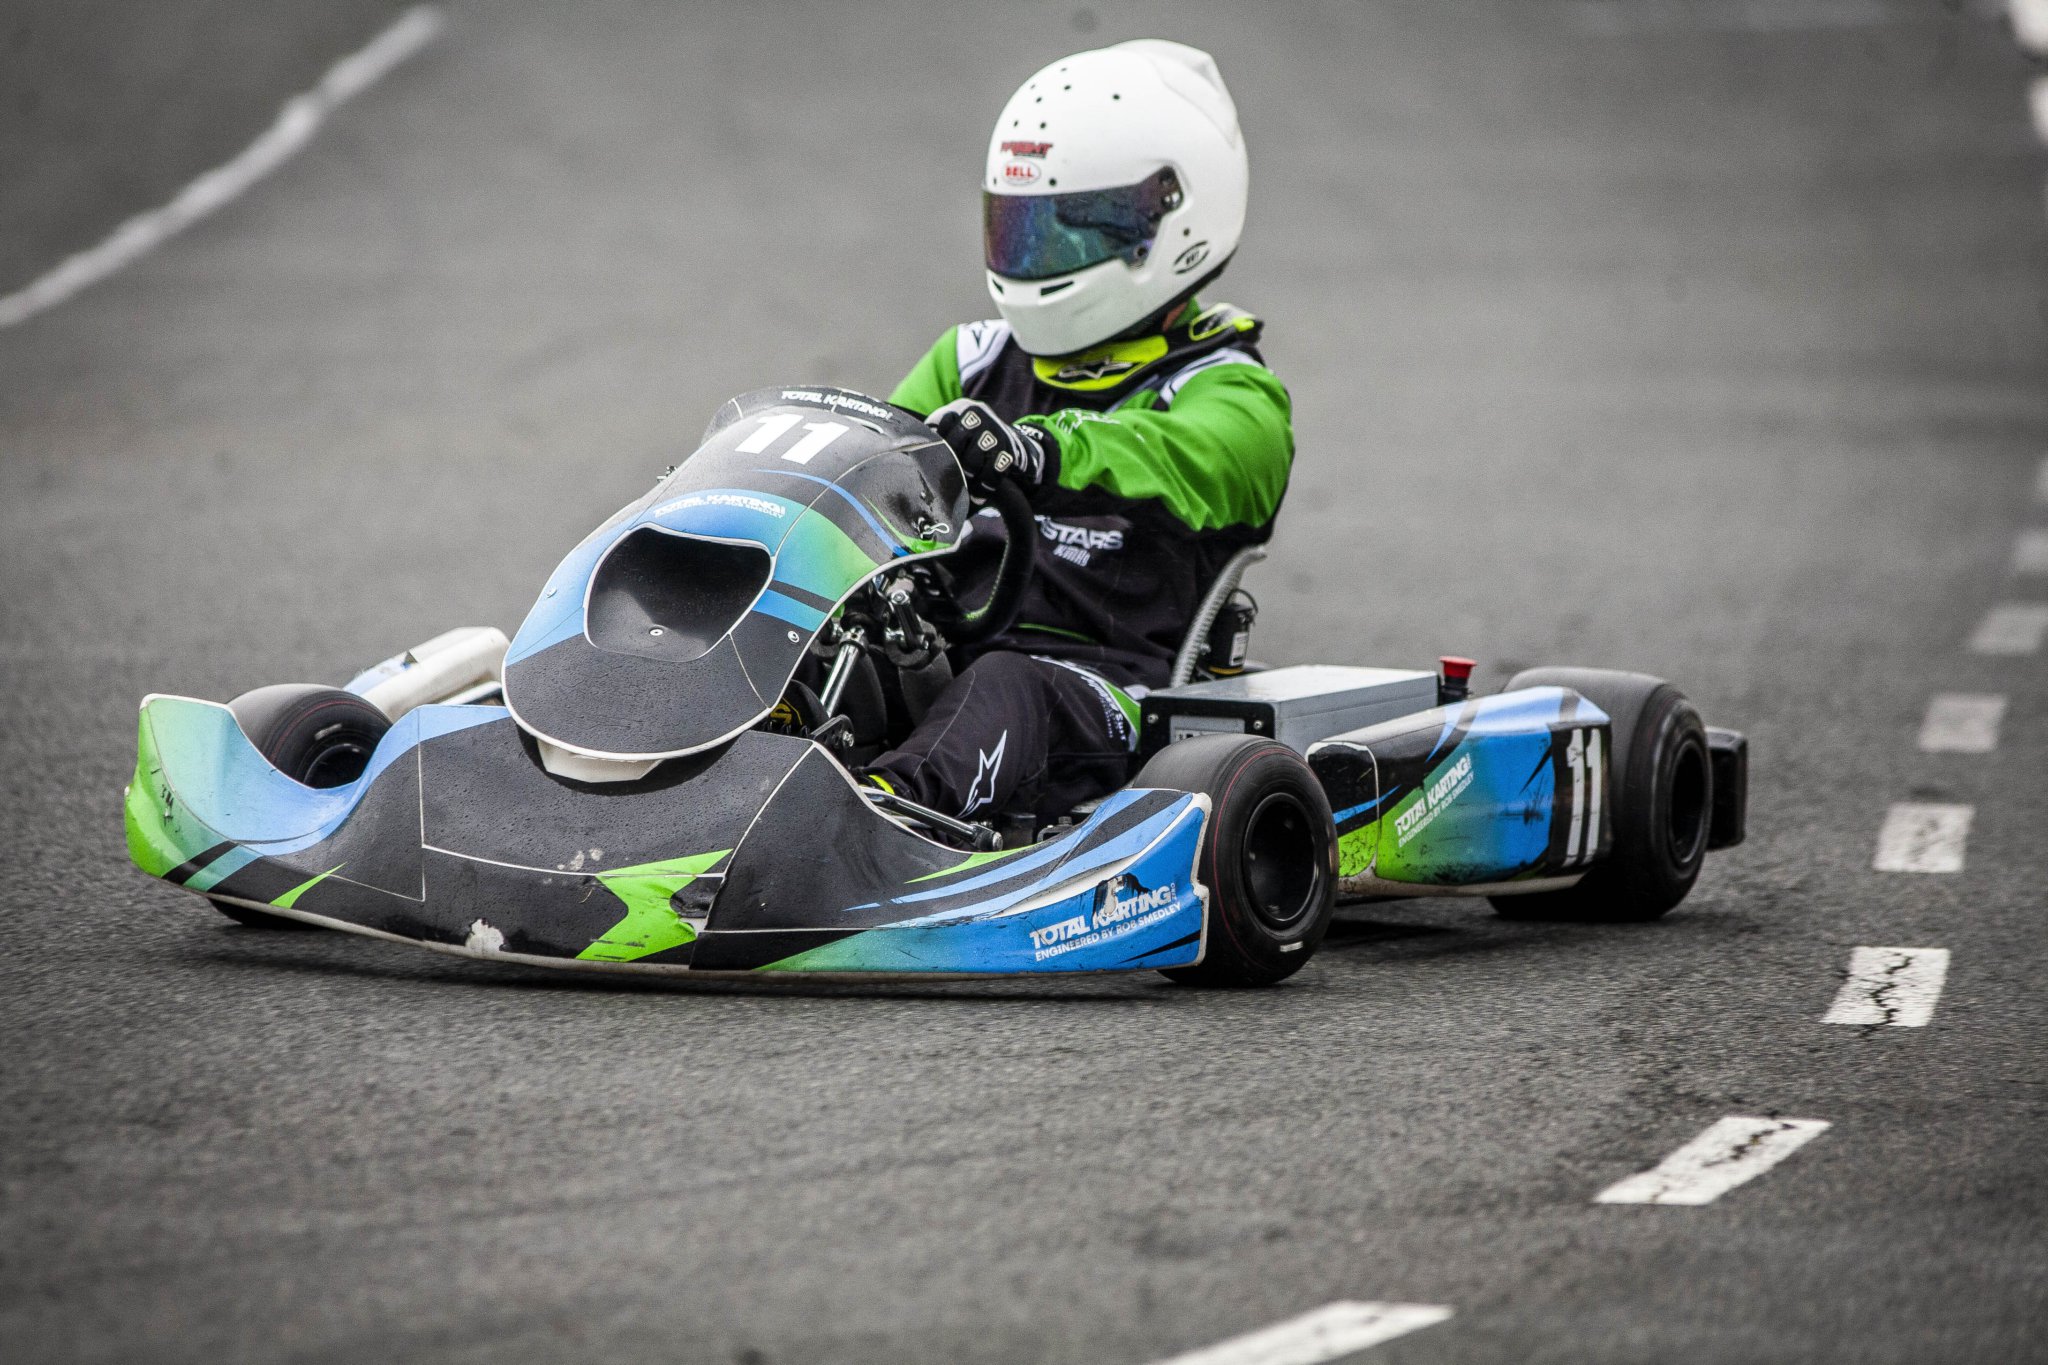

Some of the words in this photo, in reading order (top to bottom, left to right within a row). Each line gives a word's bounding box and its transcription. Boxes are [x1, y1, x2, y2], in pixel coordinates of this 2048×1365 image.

[1005, 166, 1034, 177] BELL
[781, 390, 823, 403] TOTAL
[734, 413, 850, 465] 11
[1394, 797, 1427, 836] TOTAL
[1562, 728, 1602, 868] 11
[1029, 915, 1091, 949] TOTAL
[1035, 932, 1100, 962] ENGINEERED
[1101, 927, 1114, 939] BY
[1116, 919, 1137, 935] ROB
[1138, 901, 1182, 926] SMEDLEY
